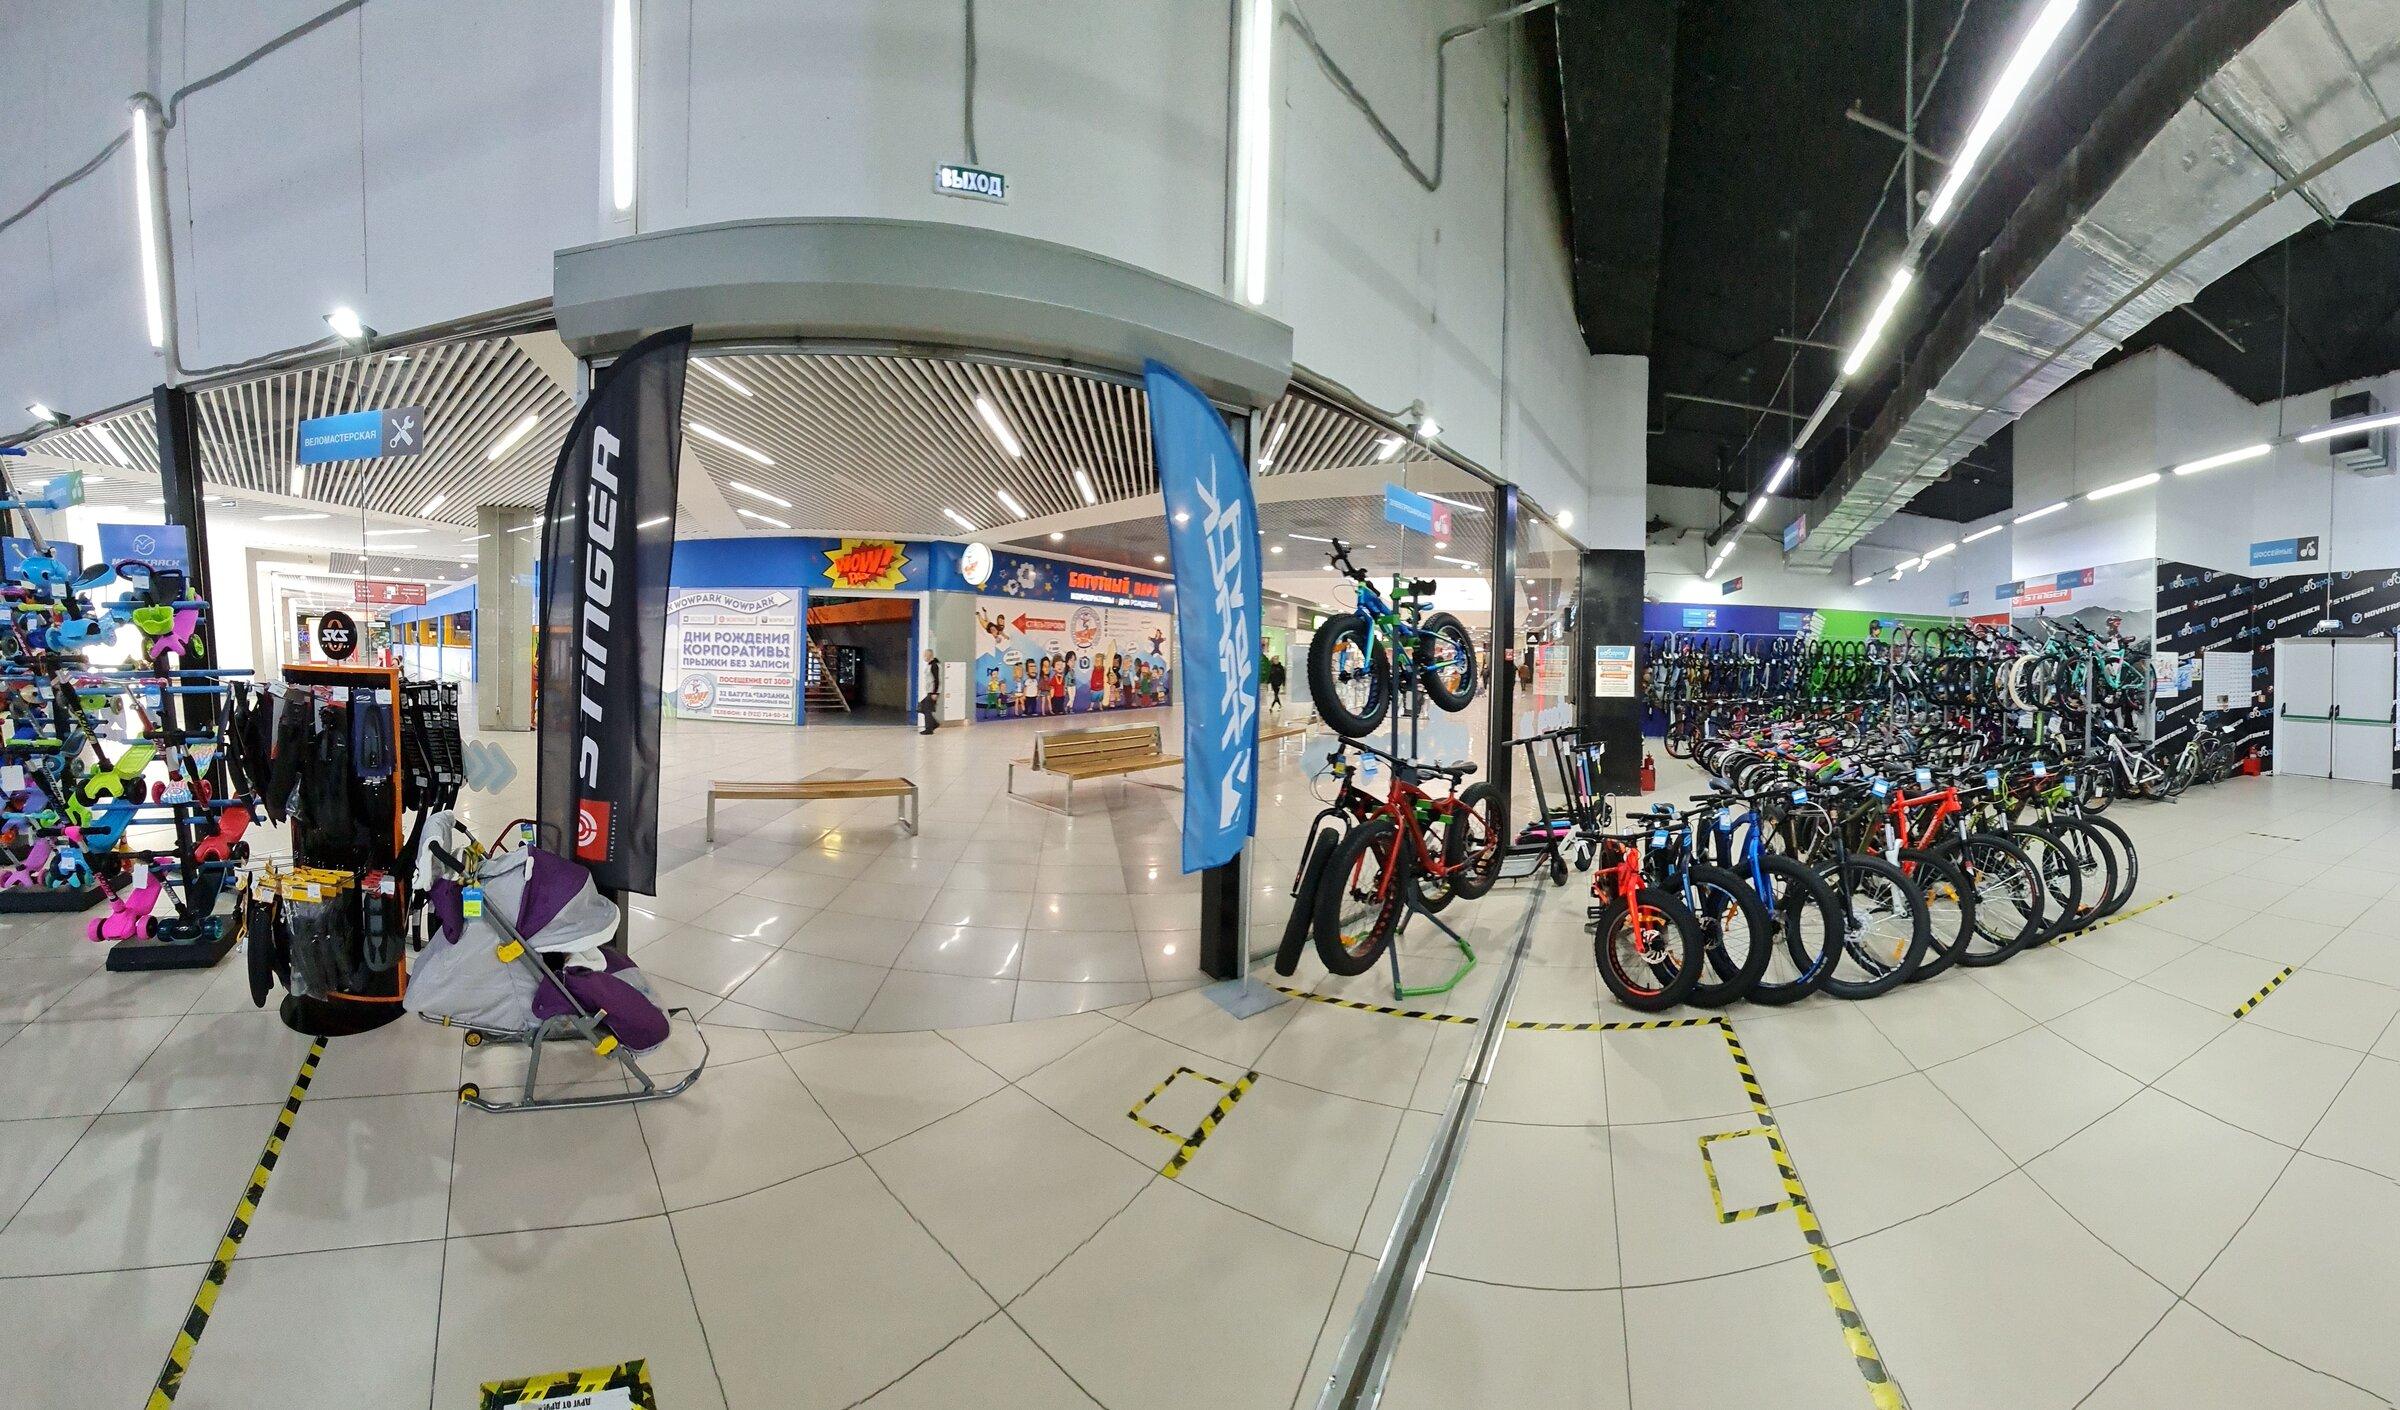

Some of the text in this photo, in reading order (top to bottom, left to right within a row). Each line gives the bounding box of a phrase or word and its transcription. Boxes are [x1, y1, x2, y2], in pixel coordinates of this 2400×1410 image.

[941, 167, 1003, 197] ВЫХОД
[304, 429, 377, 447] ВЕЛОМАСТЕРСКАЯ
[1068, 571, 1131, 594] БАТУТНЫЙ
[673, 592, 775, 611] WOWPARK WOWPARK
[2023, 590, 2068, 602] STINGER
[2257, 592, 2294, 610] STINGER
[2333, 586, 2375, 606] STINGER
[578, 425, 622, 790] STINGER
[2277, 605, 2320, 625] NOVATRACK
[321, 628, 349, 642] SKS
[683, 631, 790, 645] ДНИ РОЖДЕНИЯ
[683, 644, 790, 658] КОРПОРАТИВЫ
[682, 657, 790, 669] ПРЫЖКИ БЕЗ ЗАПИСИ
[719, 676, 762, 684] ПОСЕЩЕНИЕ
[562, 1400, 572, 1409] ОТ
[573, 1397, 591, 1409] ДРУГ
